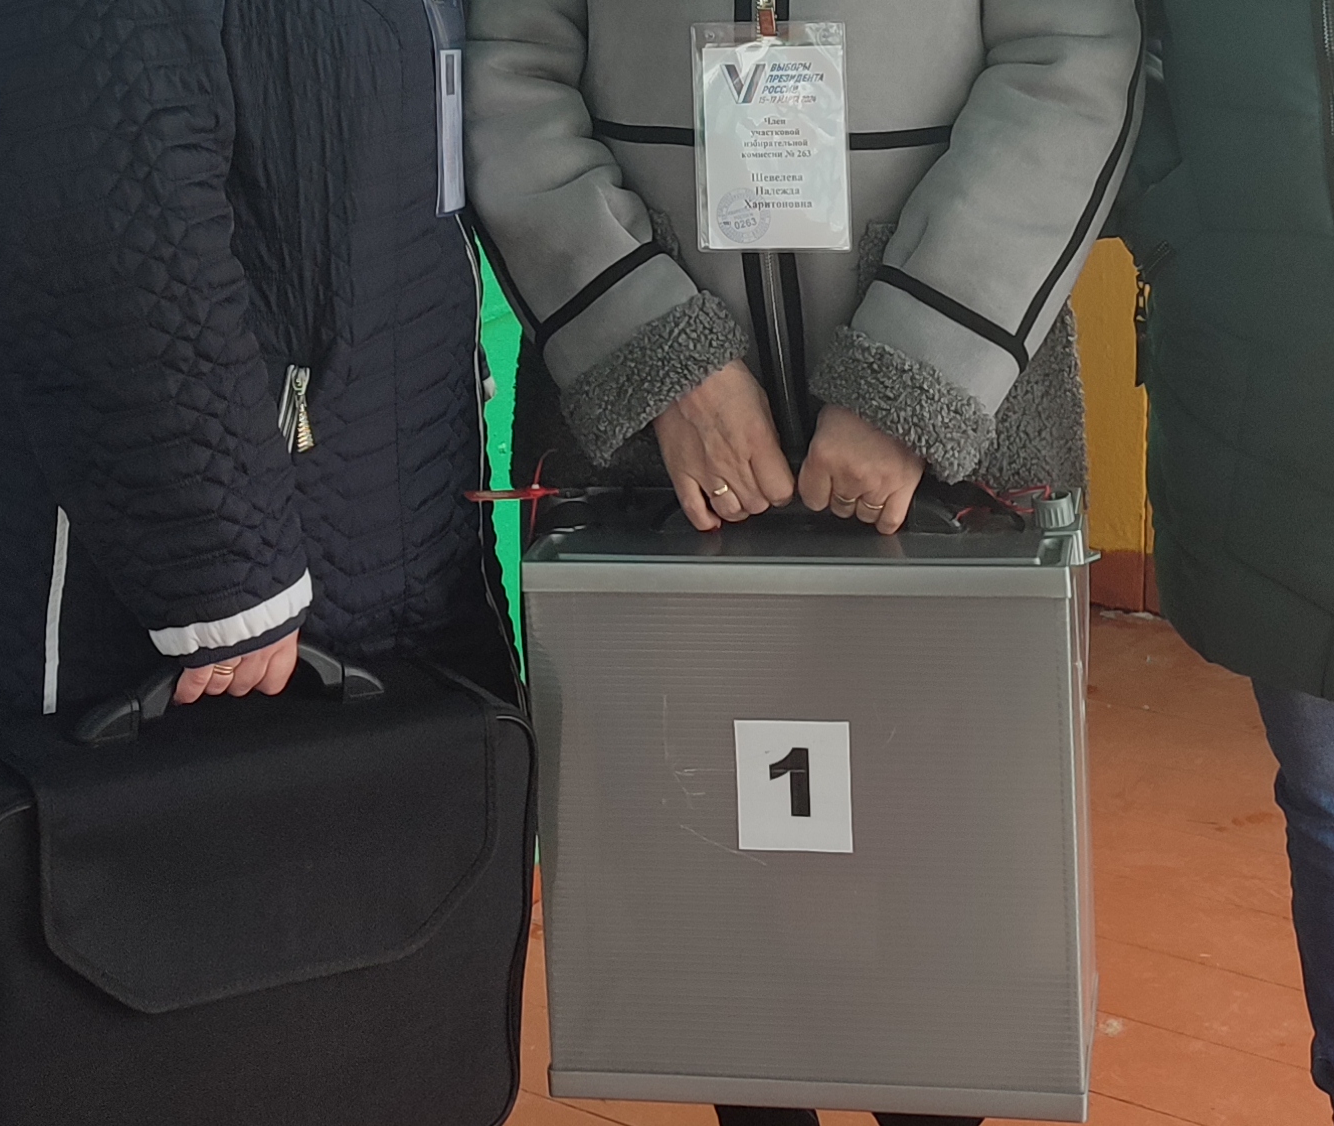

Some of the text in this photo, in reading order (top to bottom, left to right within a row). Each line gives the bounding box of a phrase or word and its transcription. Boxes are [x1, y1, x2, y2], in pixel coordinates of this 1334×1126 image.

[770, 62, 812, 72] ВЫБОРЫ
[766, 73, 824, 83] ПРЕЗИДЕНТА
[764, 117, 786, 125] Член
[750, 128, 800, 138] участковой
[744, 139, 808, 149] избирательной
[744, 199, 813, 211] Харитоновна
[768, 747, 811, 817] 1
